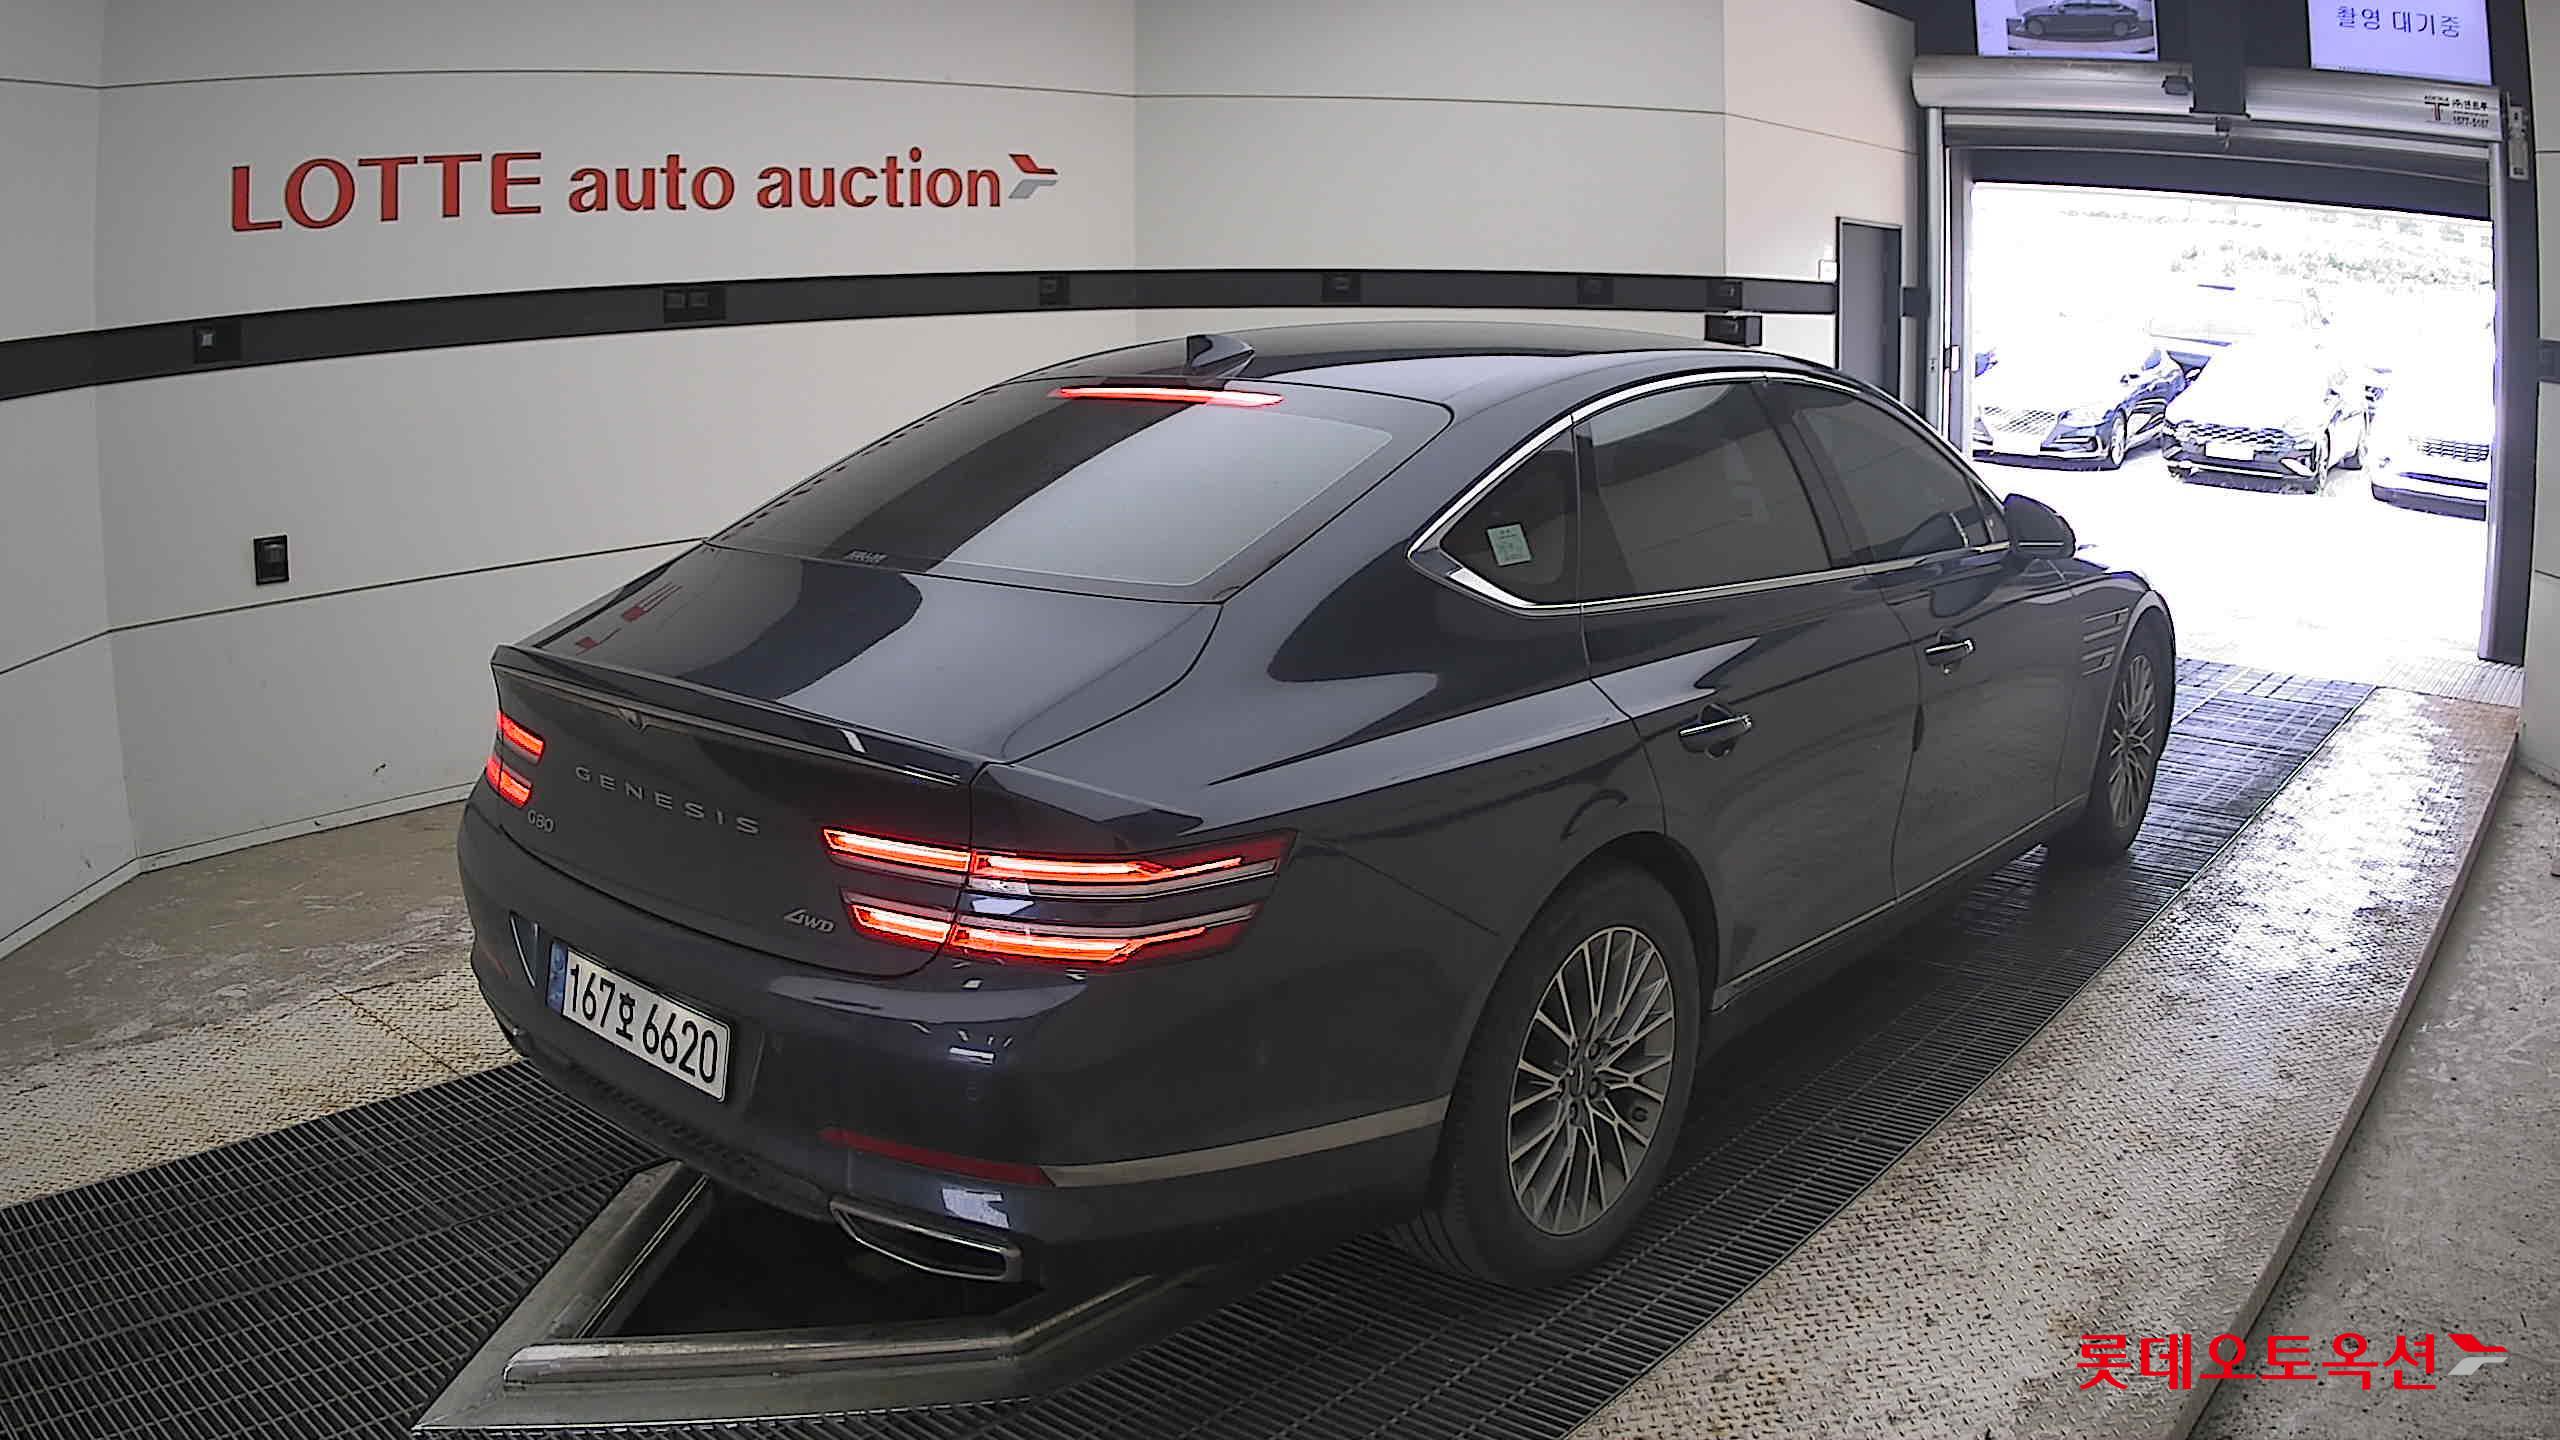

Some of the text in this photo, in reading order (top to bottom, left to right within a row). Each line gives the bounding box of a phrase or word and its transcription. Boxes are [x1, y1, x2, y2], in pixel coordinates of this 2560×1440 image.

[2337, 5, 2460, 39] 촬영 대기중
[231, 146, 1001, 233] LOTTE auto auction
[575, 766, 760, 835] GENESIS
[527, 809, 554, 832] G80
[783, 908, 835, 933] 4WD
